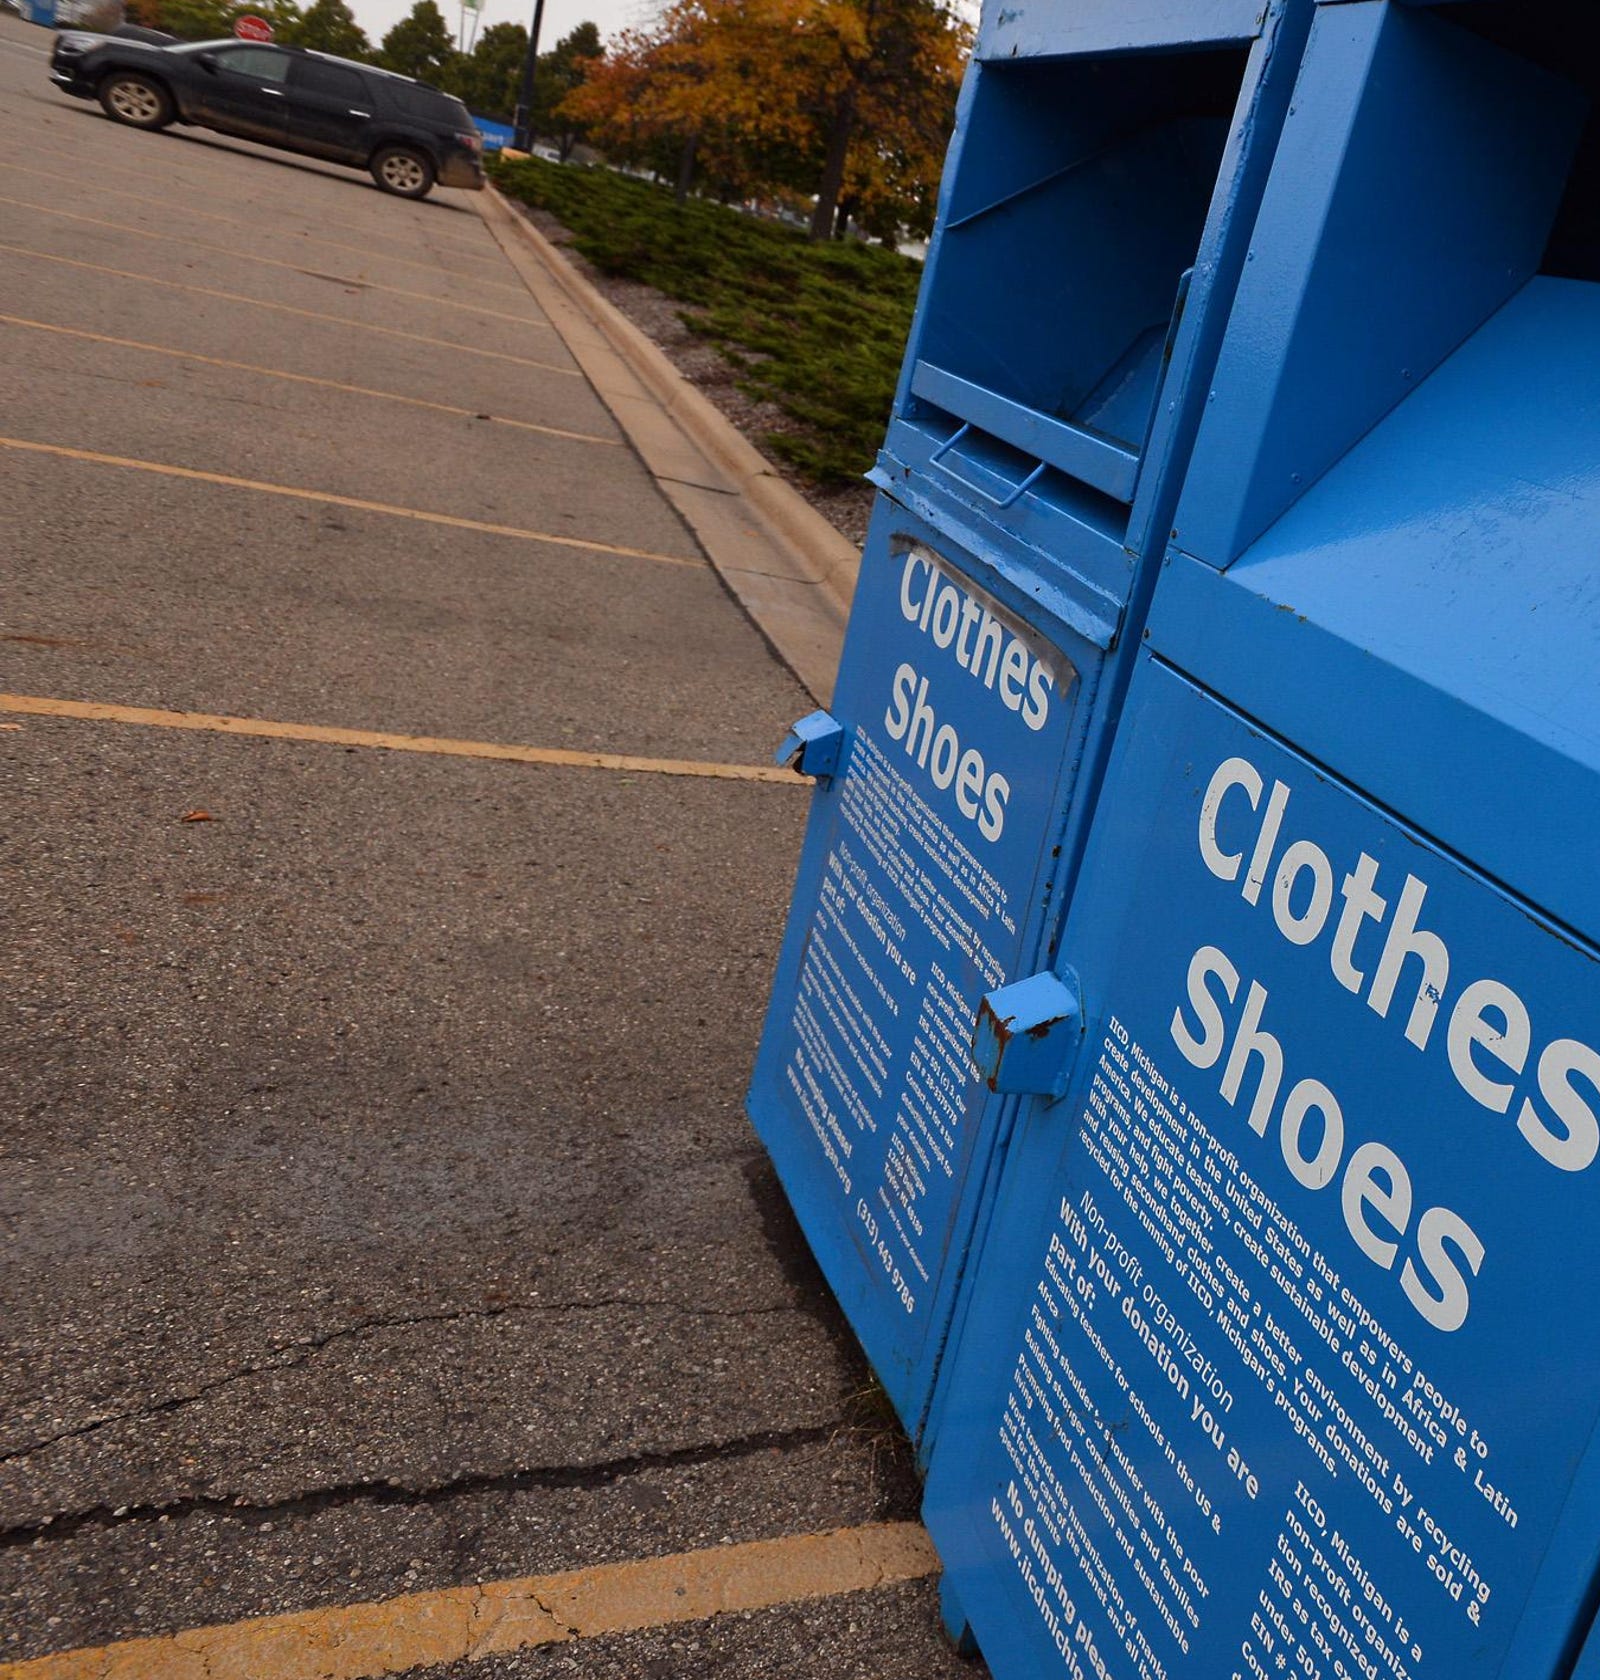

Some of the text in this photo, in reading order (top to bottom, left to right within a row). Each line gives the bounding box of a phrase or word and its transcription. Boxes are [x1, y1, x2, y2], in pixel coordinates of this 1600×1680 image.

[900, 550, 1054, 731] Clothes
[884, 663, 1010, 842] Shoes
[827, 850, 916, 986] With your donation you are
[1092, 1073, 1213, 1230] programs, and fight poverty.
[1171, 946, 1485, 1331] Shoes
[856, 1197, 914, 1313] (313) 443 9786
[1036, 1279, 1059, 1317] Africa
[1048, 1232, 1096, 1310] part of:
[1079, 1190, 1233, 1412] Non-profit organization
[1098, 1053, 1433, 1464] America. We educate teachers, create sustainable development
[1103, 1036, 1518, 1528] create development in the United States as well as in Africa & Latin
[1108, 1015, 1488, 1458] IICD, Michigan is a non-profit organization that empowers people to
[1109, 1167, 1124, 1191] for
[1122, 1186, 1139, 1214] the
[1137, 1209, 1175, 1263] running
[1174, 1258, 1189, 1277] of
[1186, 1270, 1214, 1316] IICD,
[1216, 1309, 1275, 1392] Michigan's
[1274, 1389, 1337, 1477] programs.
[1013, 1367, 1033, 1409] living
[1044, 1254, 1080, 1318] Educating
[1079, 1311, 1115, 1370] teachers
[1113, 1365, 1129, 1391] for
[1128, 1390, 1164, 1446] schools
[1175, 1459, 1194, 1492] the
[1059, 1196, 1259, 1499] With your donation you are
[1082, 1108, 1480, 1627] and reusing secondhand clothes and shoes. Your donations are sold &
[1088, 1087, 1490, 1603] With your help, we together create a better environment by recycling
[1017, 1352, 1054, 1422] Promoting
[1069, 1450, 1115, 1528] production
[1114, 1526, 1135, 1559] and
[1133, 1558, 1189, 1654] sustainable
[1024, 1328, 1053, 1384] Building
[1084, 1436, 1140, 1529] communities
[1139, 1527, 1160, 1561] and
[1159, 1557, 1199, 1628] families
[1030, 1303, 1060, 1359] Fighting
[1059, 1354, 1094, 1411] shoulder
[1102, 1428, 1143, 1491] shoulder
[1142, 1490, 1165, 1530] with
[1165, 1525, 1184, 1559] the
[1182, 1557, 1209, 1598] poor
[1006, 1479, 1024, 1518] No
[1023, 1518, 1075, 1624] dumping
[1250, 1611, 1274, 1653] EIN
[1258, 1589, 1295, 1645] under
[1267, 1557, 1293, 1598] IRS
[1291, 1597, 1309, 1624] as
[1309, 1620, 1333, 1660] tax
[1276, 1532, 1377, 1680] tion recognized
[1285, 1509, 1351, 1606] non-profit
[1293, 1480, 1422, 1662] IICD, Michigan is a
